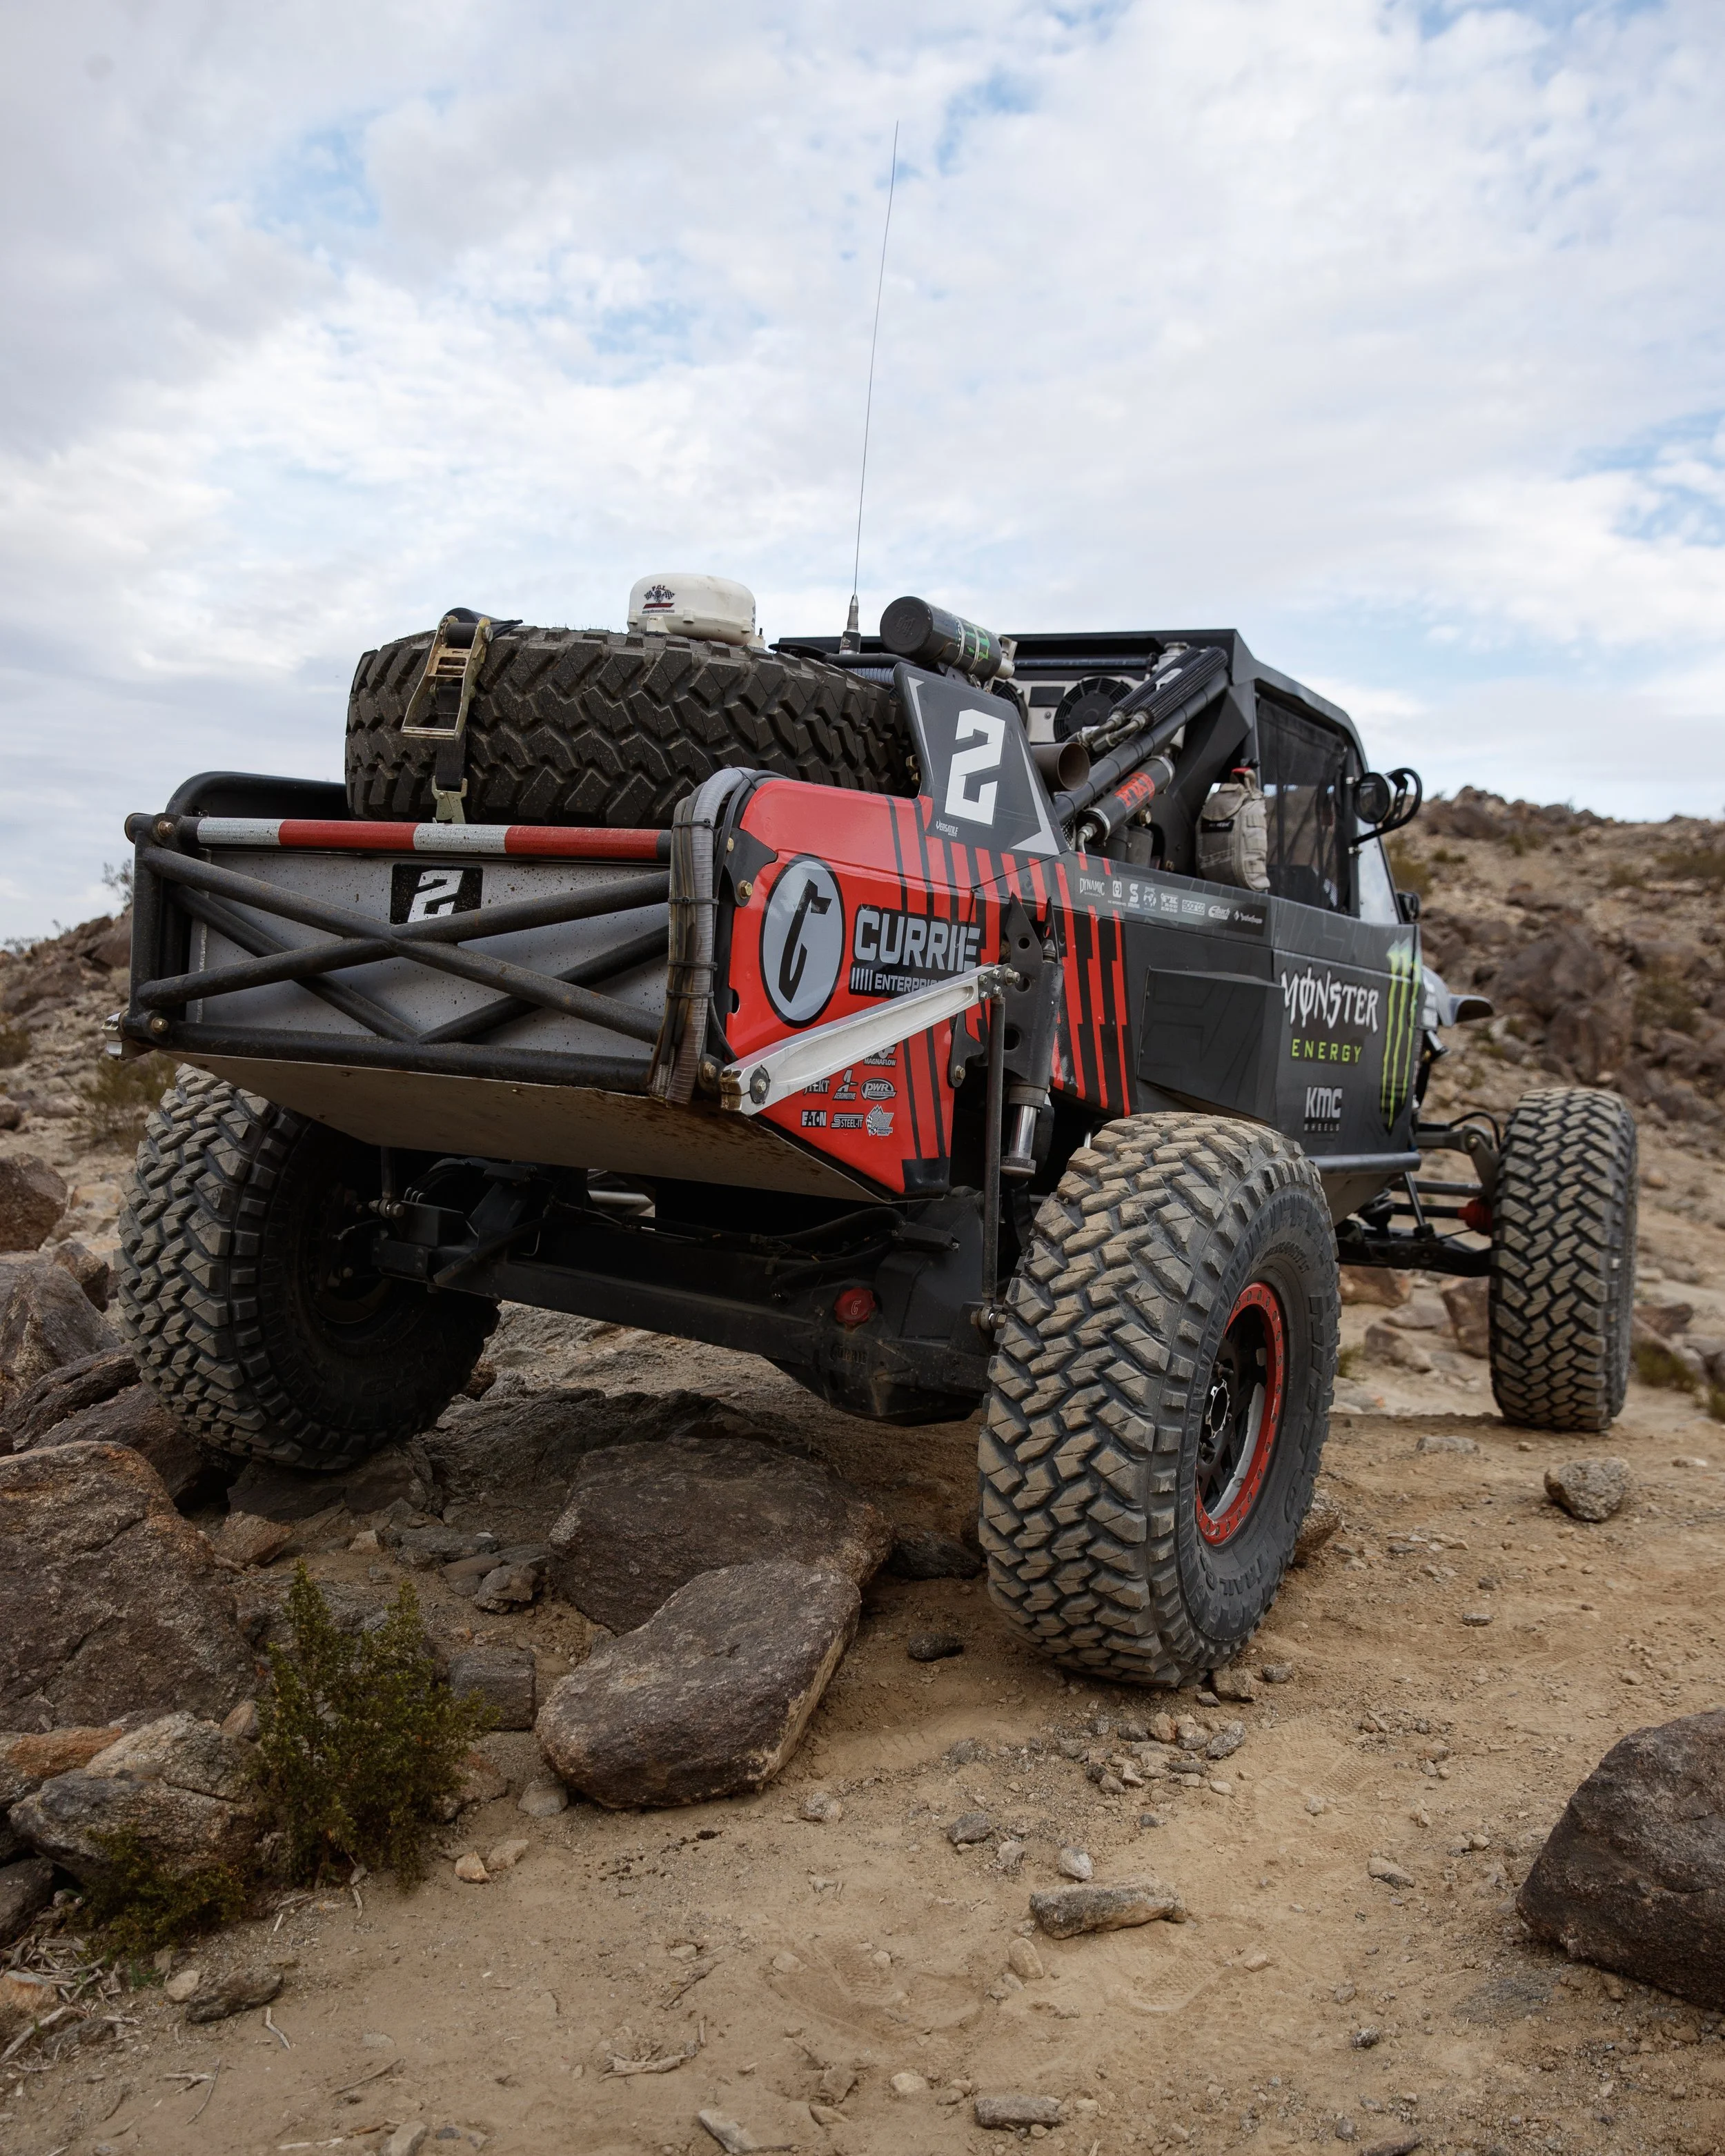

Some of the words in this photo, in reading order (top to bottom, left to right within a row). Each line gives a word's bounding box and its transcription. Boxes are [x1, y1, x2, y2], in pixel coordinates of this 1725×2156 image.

[945, 709, 1006, 825] 2
[936, 818, 958, 834] VERSATILE
[407, 870, 464, 923] 2
[1080, 878, 1105, 896] DYNAMIC
[855, 909, 980, 972] CURRIE
[875, 973, 943, 992] ENTERPR
[1281, 967, 1379, 1033] MONSTER
[1291, 1038, 1362, 1063] ENERGY
[1305, 1087, 1343, 1118] KMC
[802, 1111, 827, 1126] EATON
[840, 1118, 863, 1127] STEEL-IT
